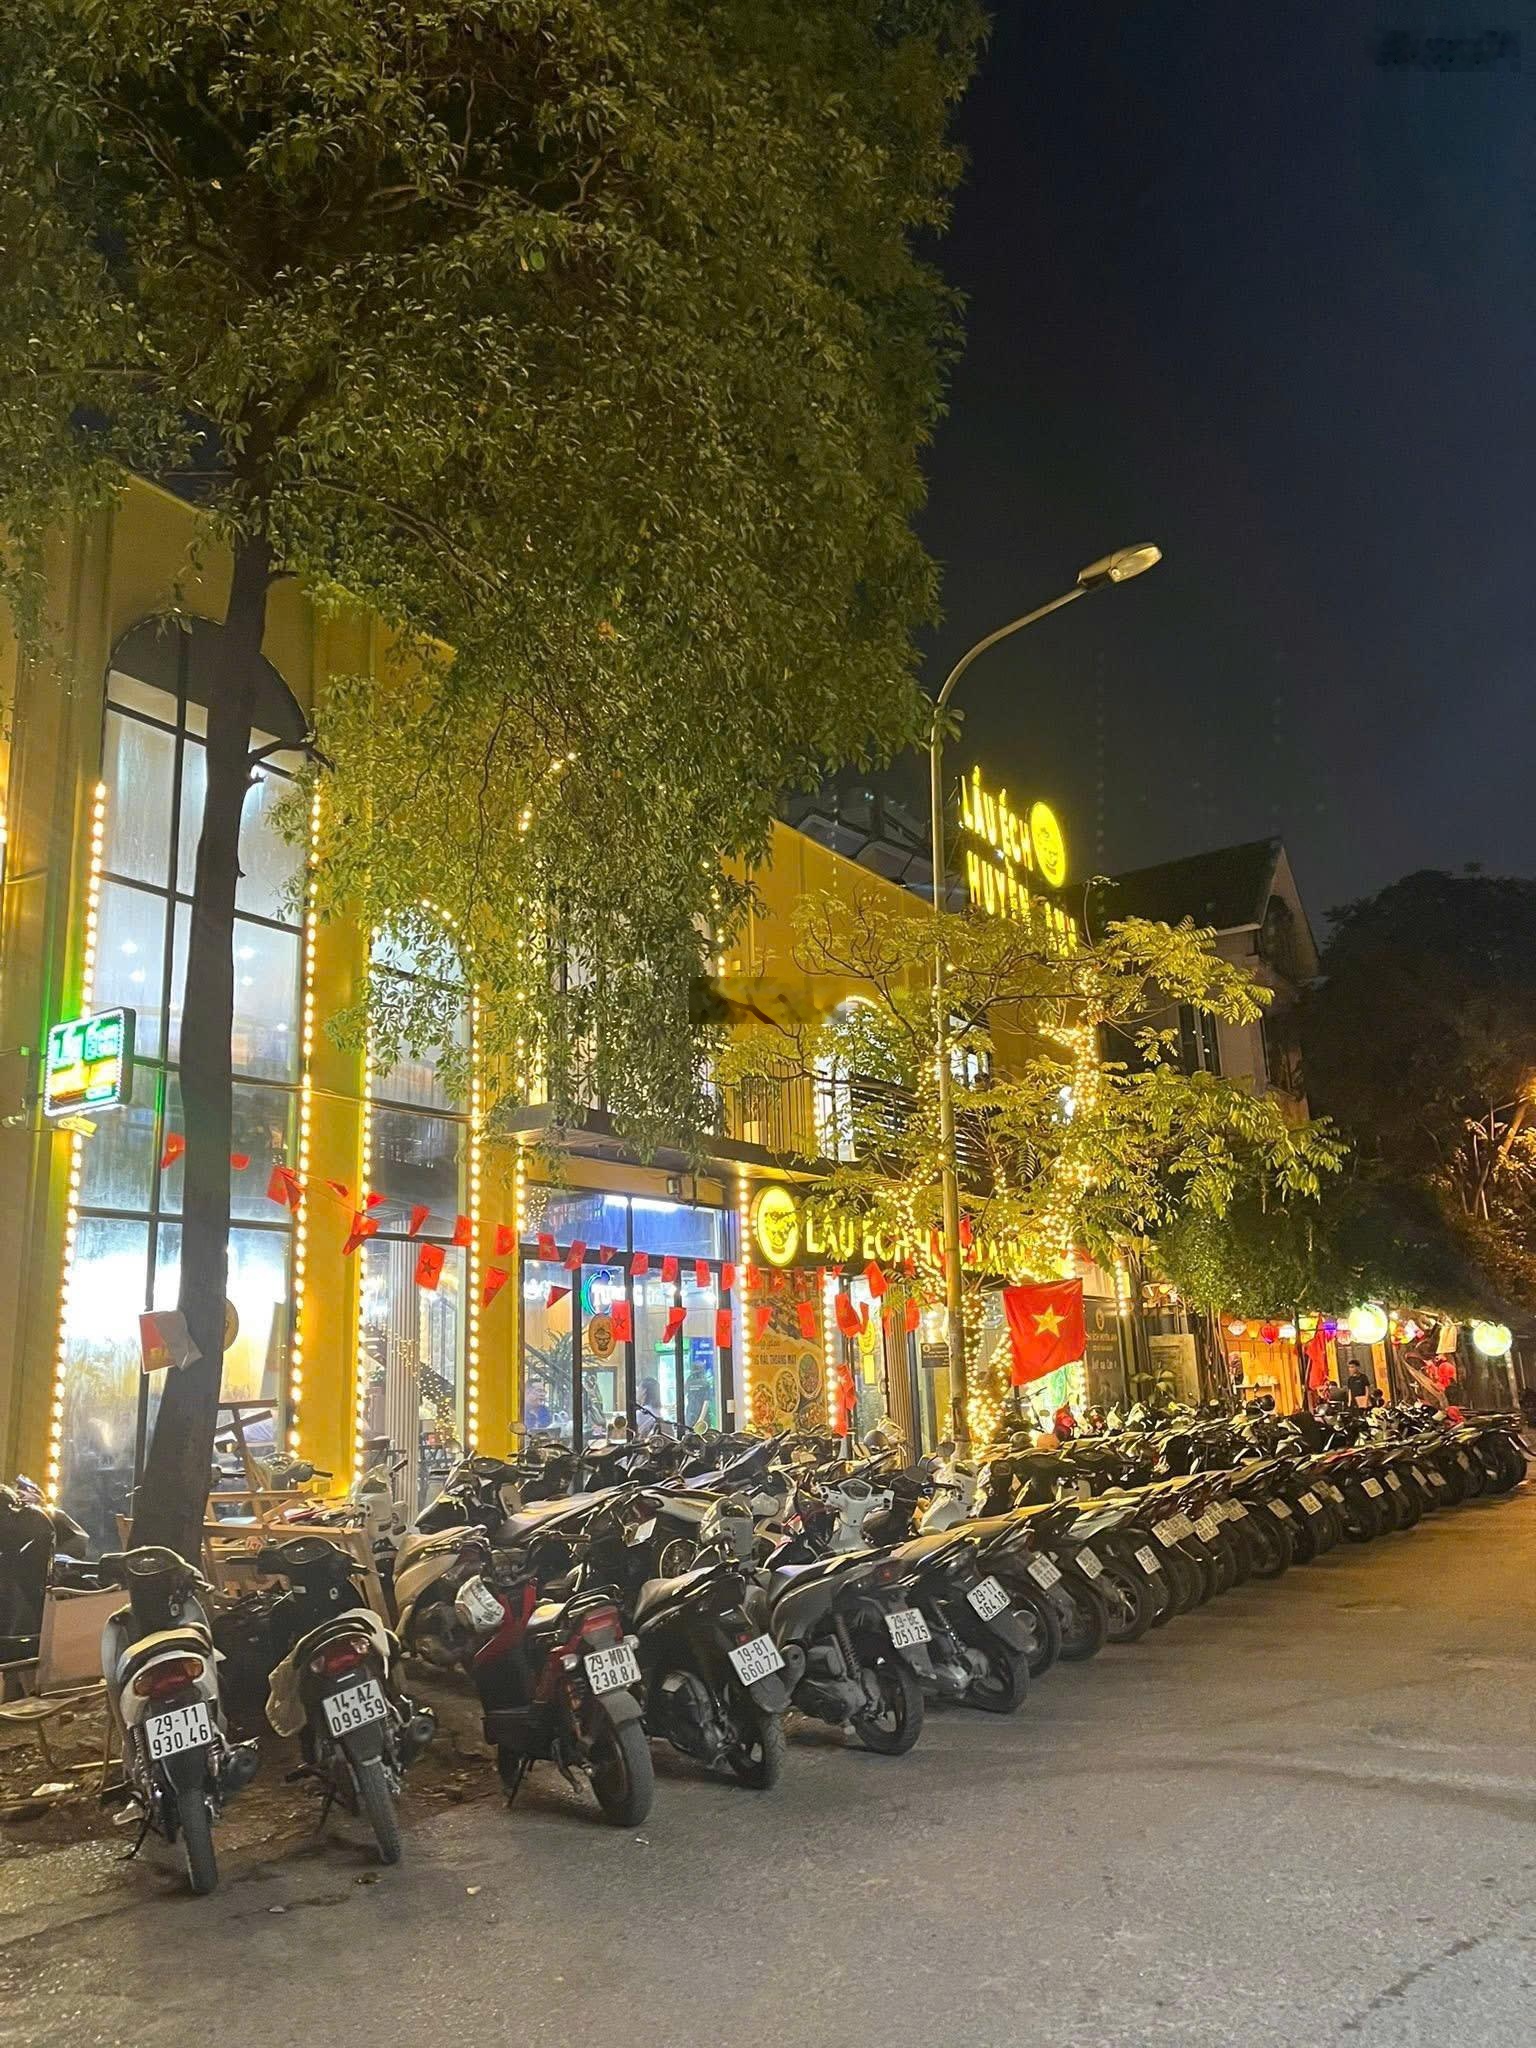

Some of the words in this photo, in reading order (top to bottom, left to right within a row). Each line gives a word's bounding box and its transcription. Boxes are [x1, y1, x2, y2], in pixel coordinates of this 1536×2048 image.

[806, 1194, 855, 1258] LẨU
[737, 1639, 769, 1664] 19-B1
[740, 1651, 778, 1682] 660.77
[332, 1683, 375, 1713] 14-AZ
[154, 1706, 199, 1736] 29-T1
[331, 1698, 385, 1733] 099.59
[152, 1723, 209, 1757] 930.46
